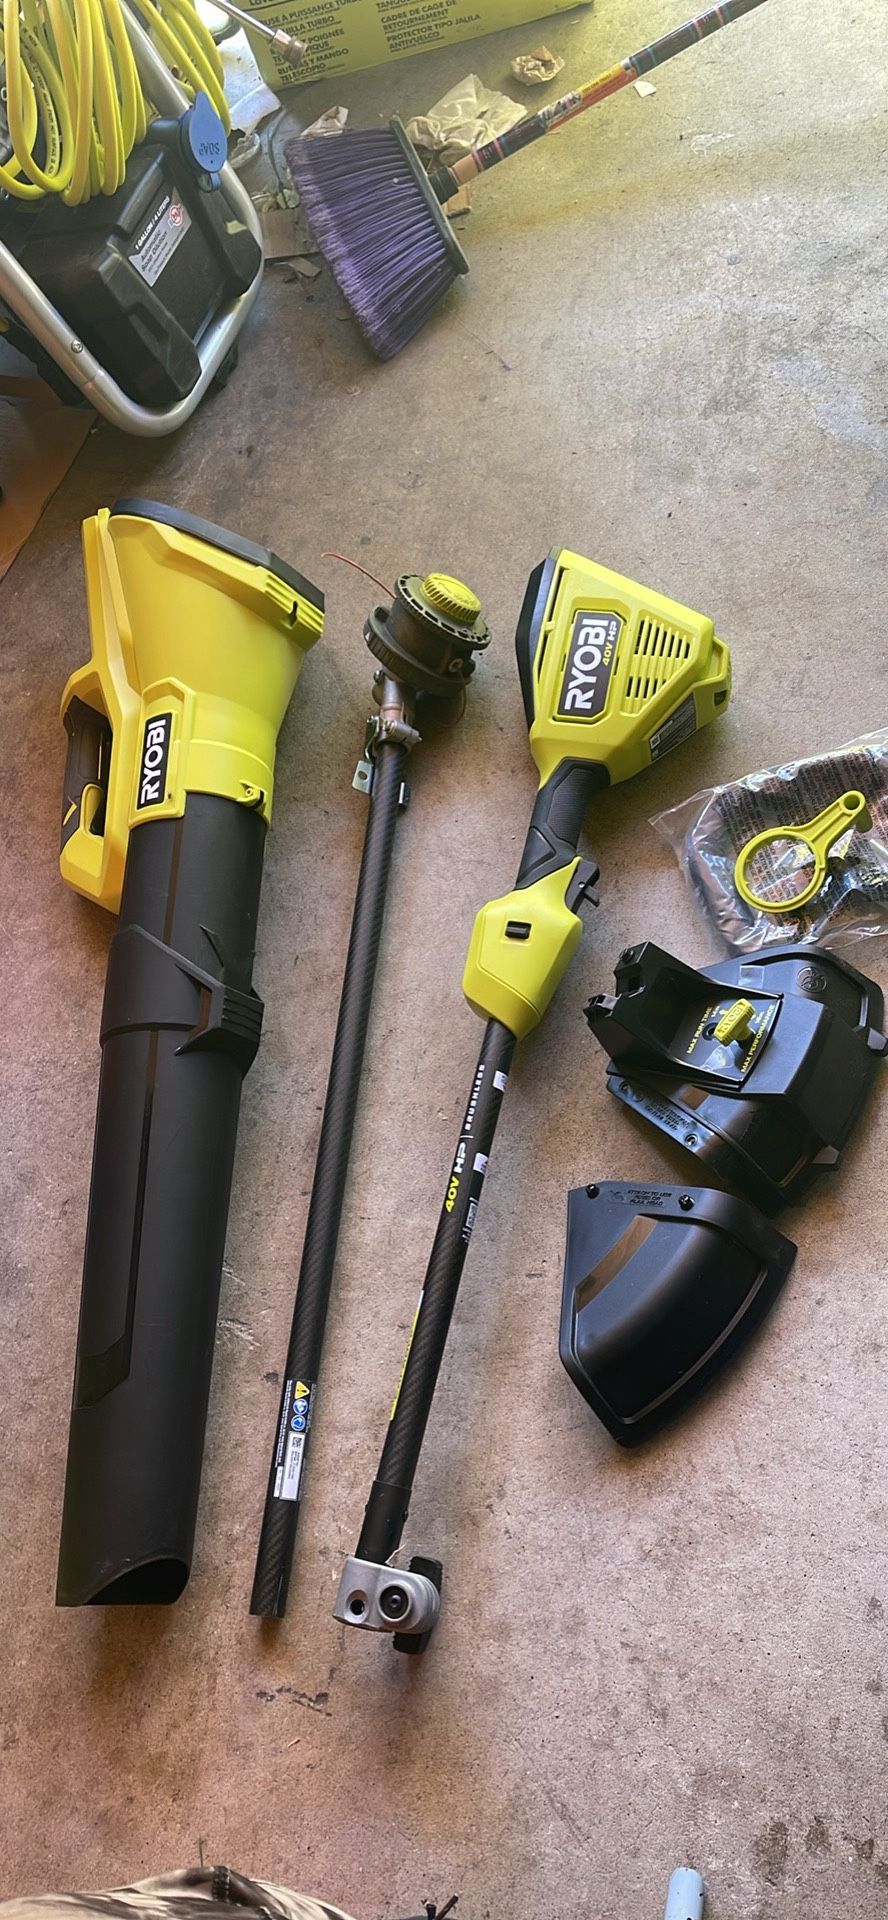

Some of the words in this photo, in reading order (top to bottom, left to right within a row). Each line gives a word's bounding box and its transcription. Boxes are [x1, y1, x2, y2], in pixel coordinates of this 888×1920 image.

[289, 2, 333, 18] PUISSANCE
[381, 11, 407, 23] CADRE
[409, 8, 419, 16] DE
[421, 3, 444, 13] CAGE
[383, 8, 449, 31] RETOURNEMENT
[307, 16, 335, 28] TURBO
[387, 25, 432, 41] PROTECTOR
[435, 20, 453, 30] TIPO
[389, 31, 440, 49] ANTIVUELCO
[316, 48, 349, 60] MANGO
[280, 63, 326, 82] TELESCOPIO
[199, 142, 219, 155] SOAP
[137, 222, 153, 247] GALLON
[156, 195, 170, 217] LITERS
[141, 254, 154, 272] Soap
[607, 620, 617, 641] HP
[564, 618, 610, 710] RYOBI
[602, 641, 613, 666] 40V
[140, 719, 166, 804] RYOBI
[686, 1037, 697, 1054] MAX
[694, 1023, 705, 1038] RUN
[701, 1006, 713, 1022] TIME
[740, 1056, 751, 1073] MAX
[748, 1004, 775, 1056] PERFORMANCE
[445, 1175, 460, 1213] 40V
[453, 1142, 466, 1174] HP
[464, 1064, 485, 1131] BRUSHLESS
